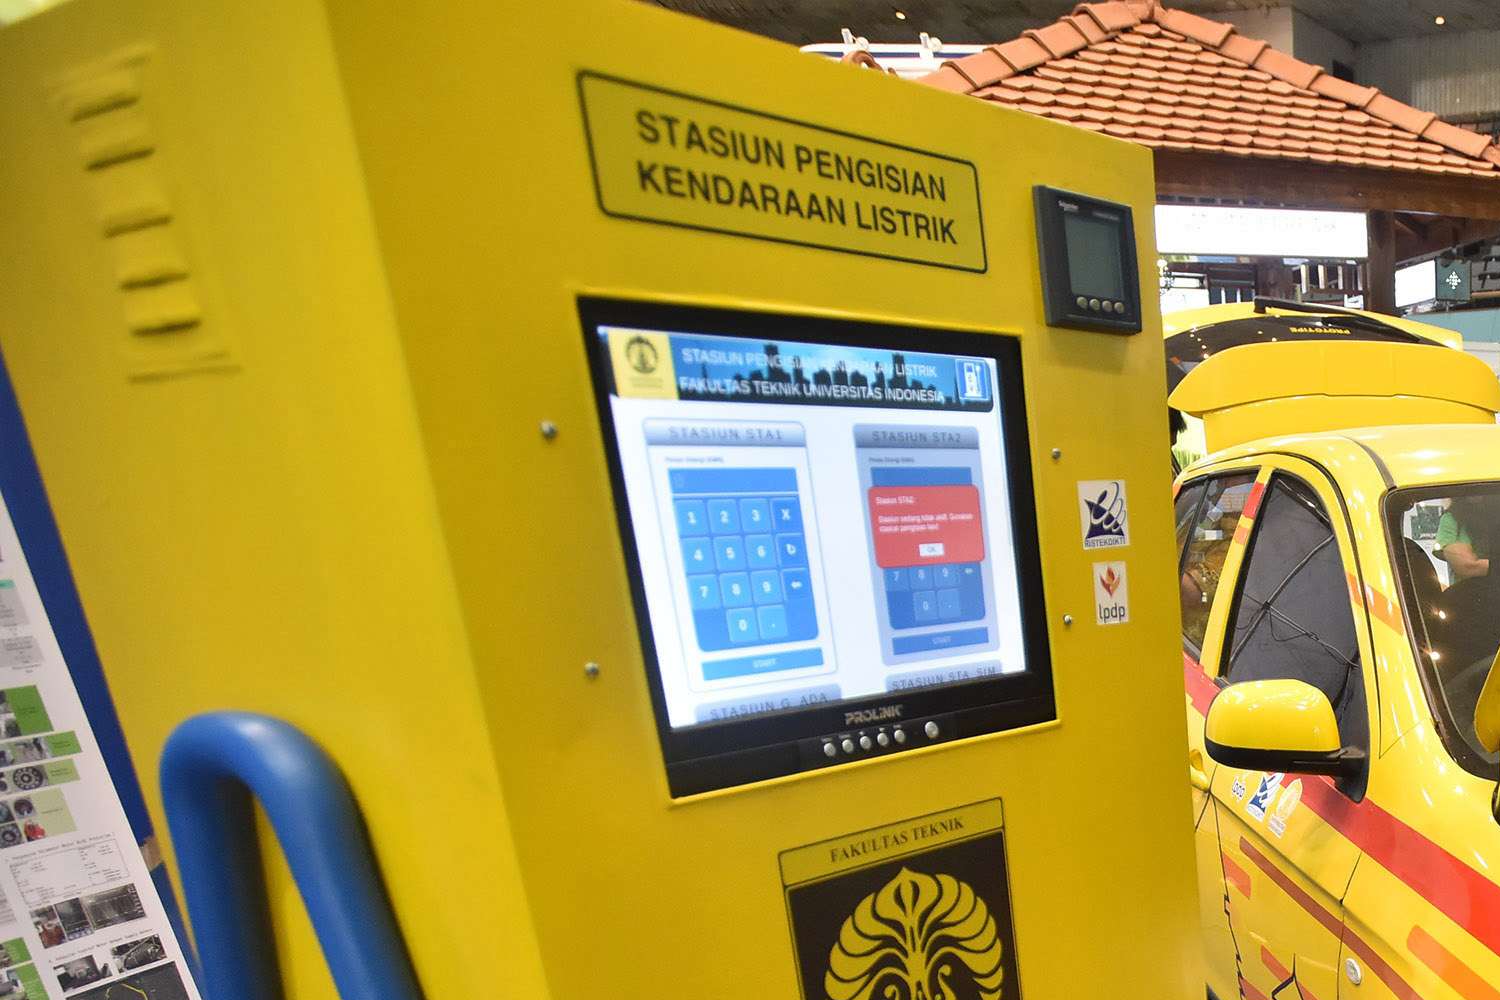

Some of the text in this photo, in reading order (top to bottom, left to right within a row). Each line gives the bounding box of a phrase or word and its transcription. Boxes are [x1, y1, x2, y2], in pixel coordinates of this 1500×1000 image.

[636, 109, 947, 202] STASIUN PENGISIAN
[637, 160, 957, 244] KENDARAAN LISTRIK
[681, 348, 743, 366] STASIUN
[895, 361, 937, 378] LISTRIK
[679, 376, 750, 393] FAKULTAS
[754, 380, 801, 396] TEKNIK
[803, 384, 882, 399] UNIVERSITAS
[885, 387, 944, 402] INDONESIA
[669, 427, 783, 440] STASIUN STA1
[872, 431, 961, 443] STASIUN STA2
[1098, 602, 1126, 624] lpdp
[891, 675, 943, 690] STASIUN
[710, 701, 774, 721] STASIUN
[844, 705, 901, 725] PROLINK
[829, 816, 964, 863] FAKULTAS TEKNIK
